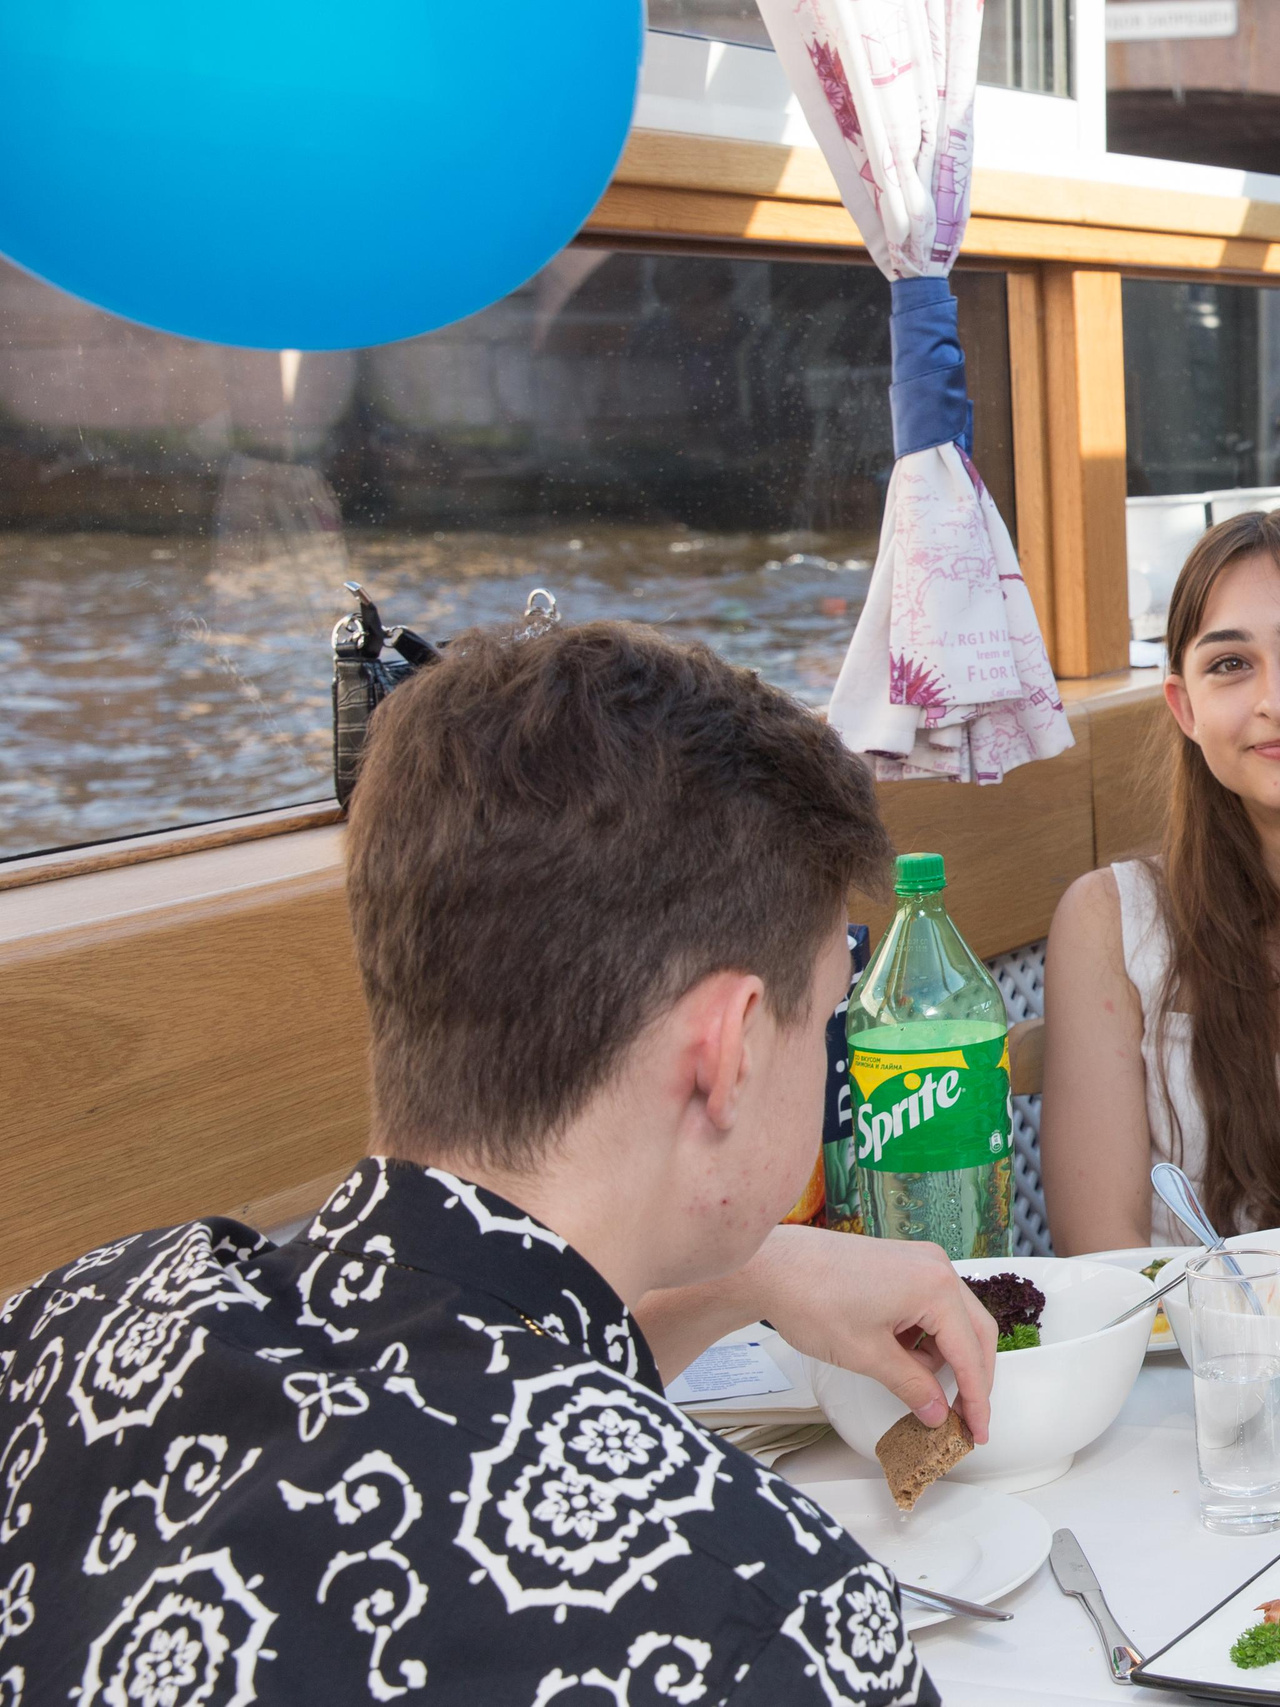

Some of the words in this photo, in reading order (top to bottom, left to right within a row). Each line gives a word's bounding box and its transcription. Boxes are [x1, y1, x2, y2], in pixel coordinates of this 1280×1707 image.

[967, 664, 1015, 682] FLORI
[861, 1055, 881, 1063] ВКУСОМ
[857, 1070, 962, 1163] Sprite
